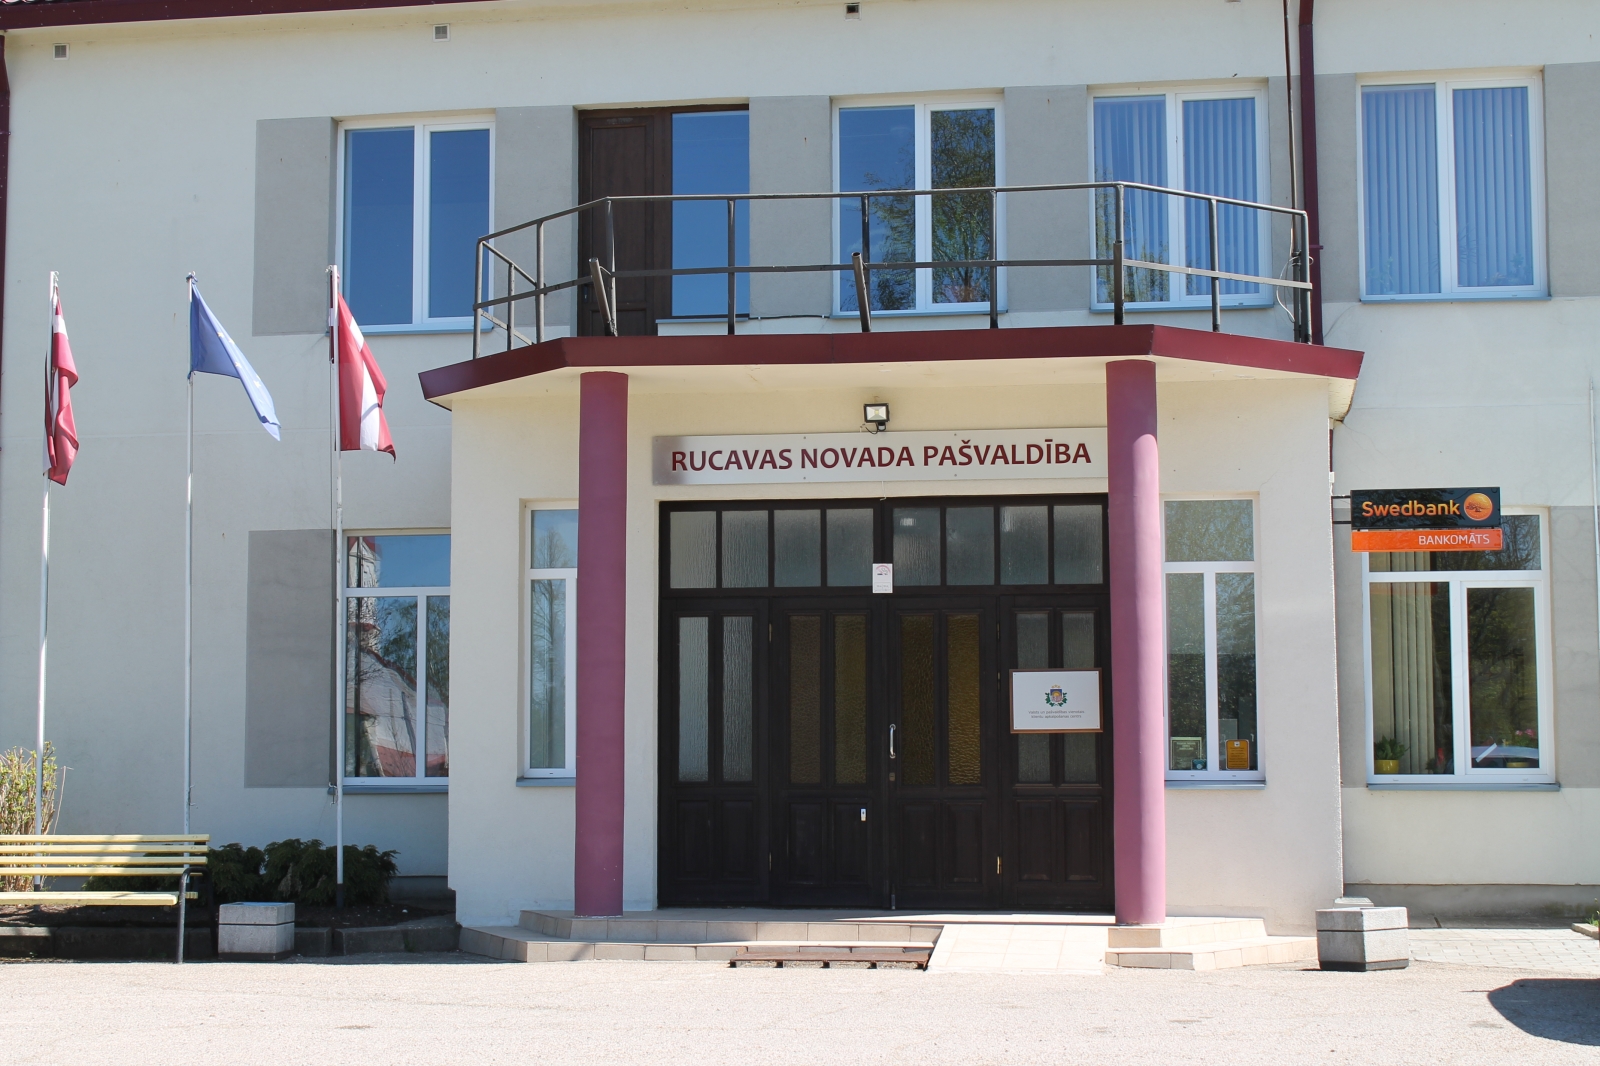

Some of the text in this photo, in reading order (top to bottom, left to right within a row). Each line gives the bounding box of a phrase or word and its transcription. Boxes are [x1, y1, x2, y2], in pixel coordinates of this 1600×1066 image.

[671, 438, 1092, 471] RUCAVAS NOVADA PAŠVALDĪBA
[1361, 500, 1460, 516] Swedbank
[1418, 533, 1490, 545] BANKOMĀTS
